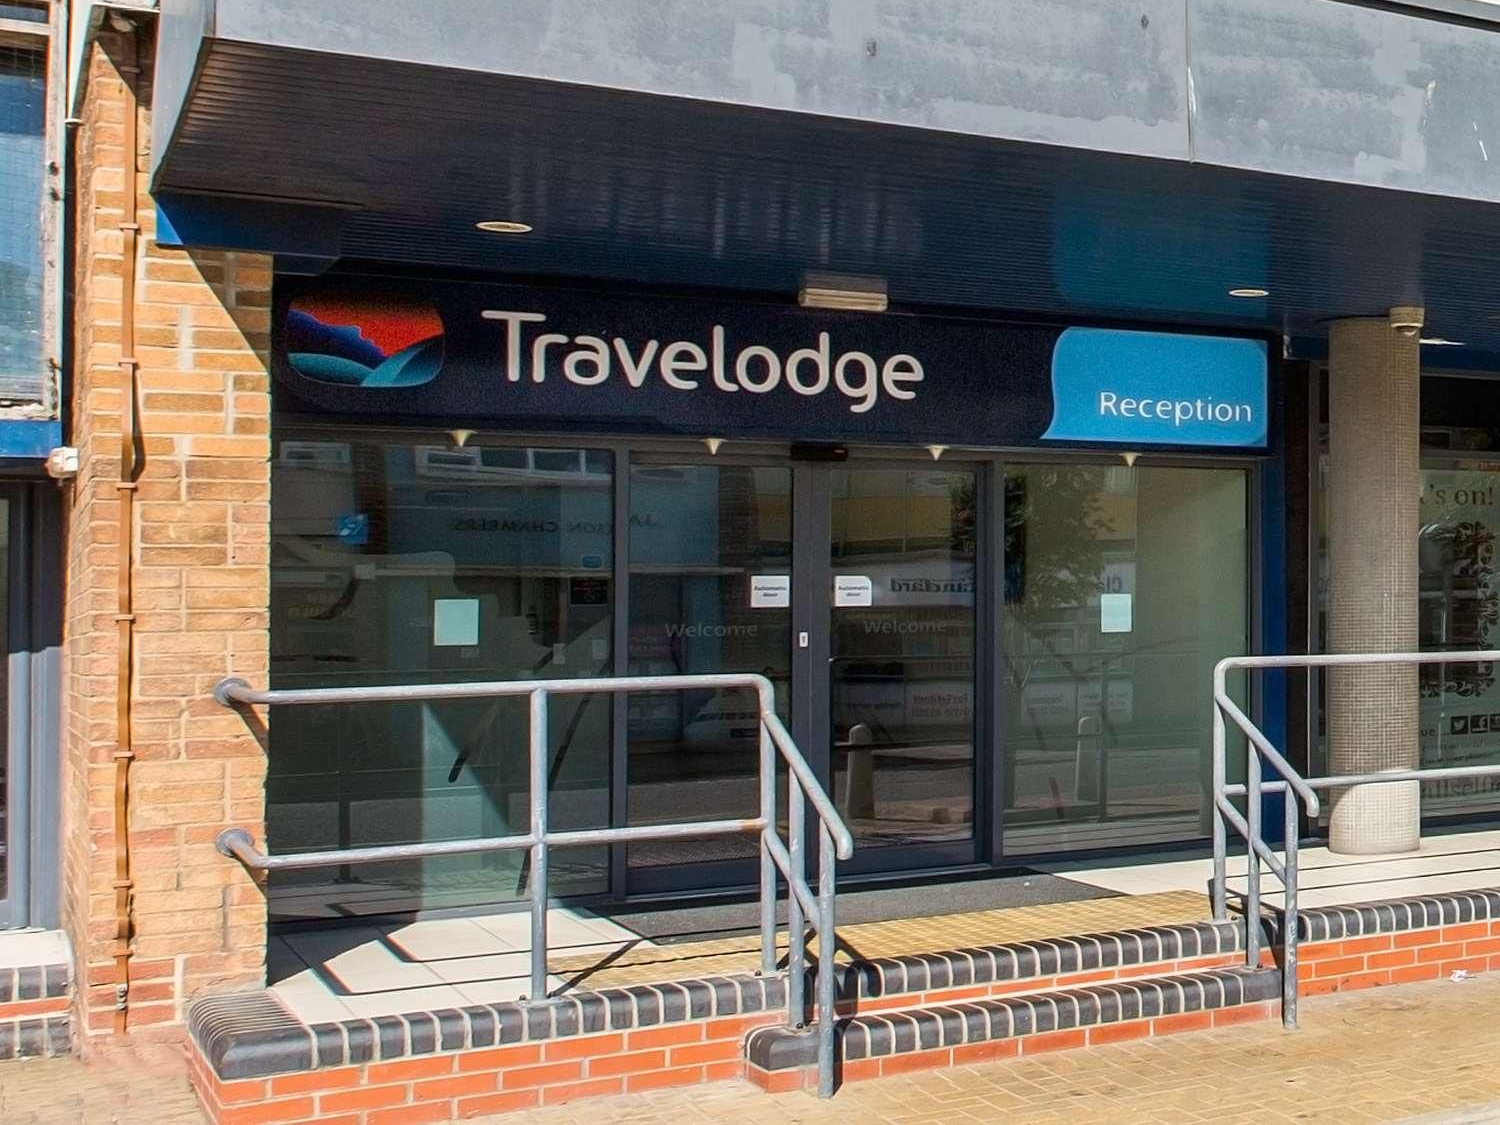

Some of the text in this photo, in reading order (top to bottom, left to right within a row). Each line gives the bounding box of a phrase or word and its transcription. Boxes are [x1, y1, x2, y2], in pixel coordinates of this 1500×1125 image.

[481, 309, 925, 413] Travelodge
[1099, 391, 1253, 427] Reception
[1454, 486, 1494, 507] on!
[664, 622, 758, 638] Welcome
[862, 616, 948, 635] Welcome
